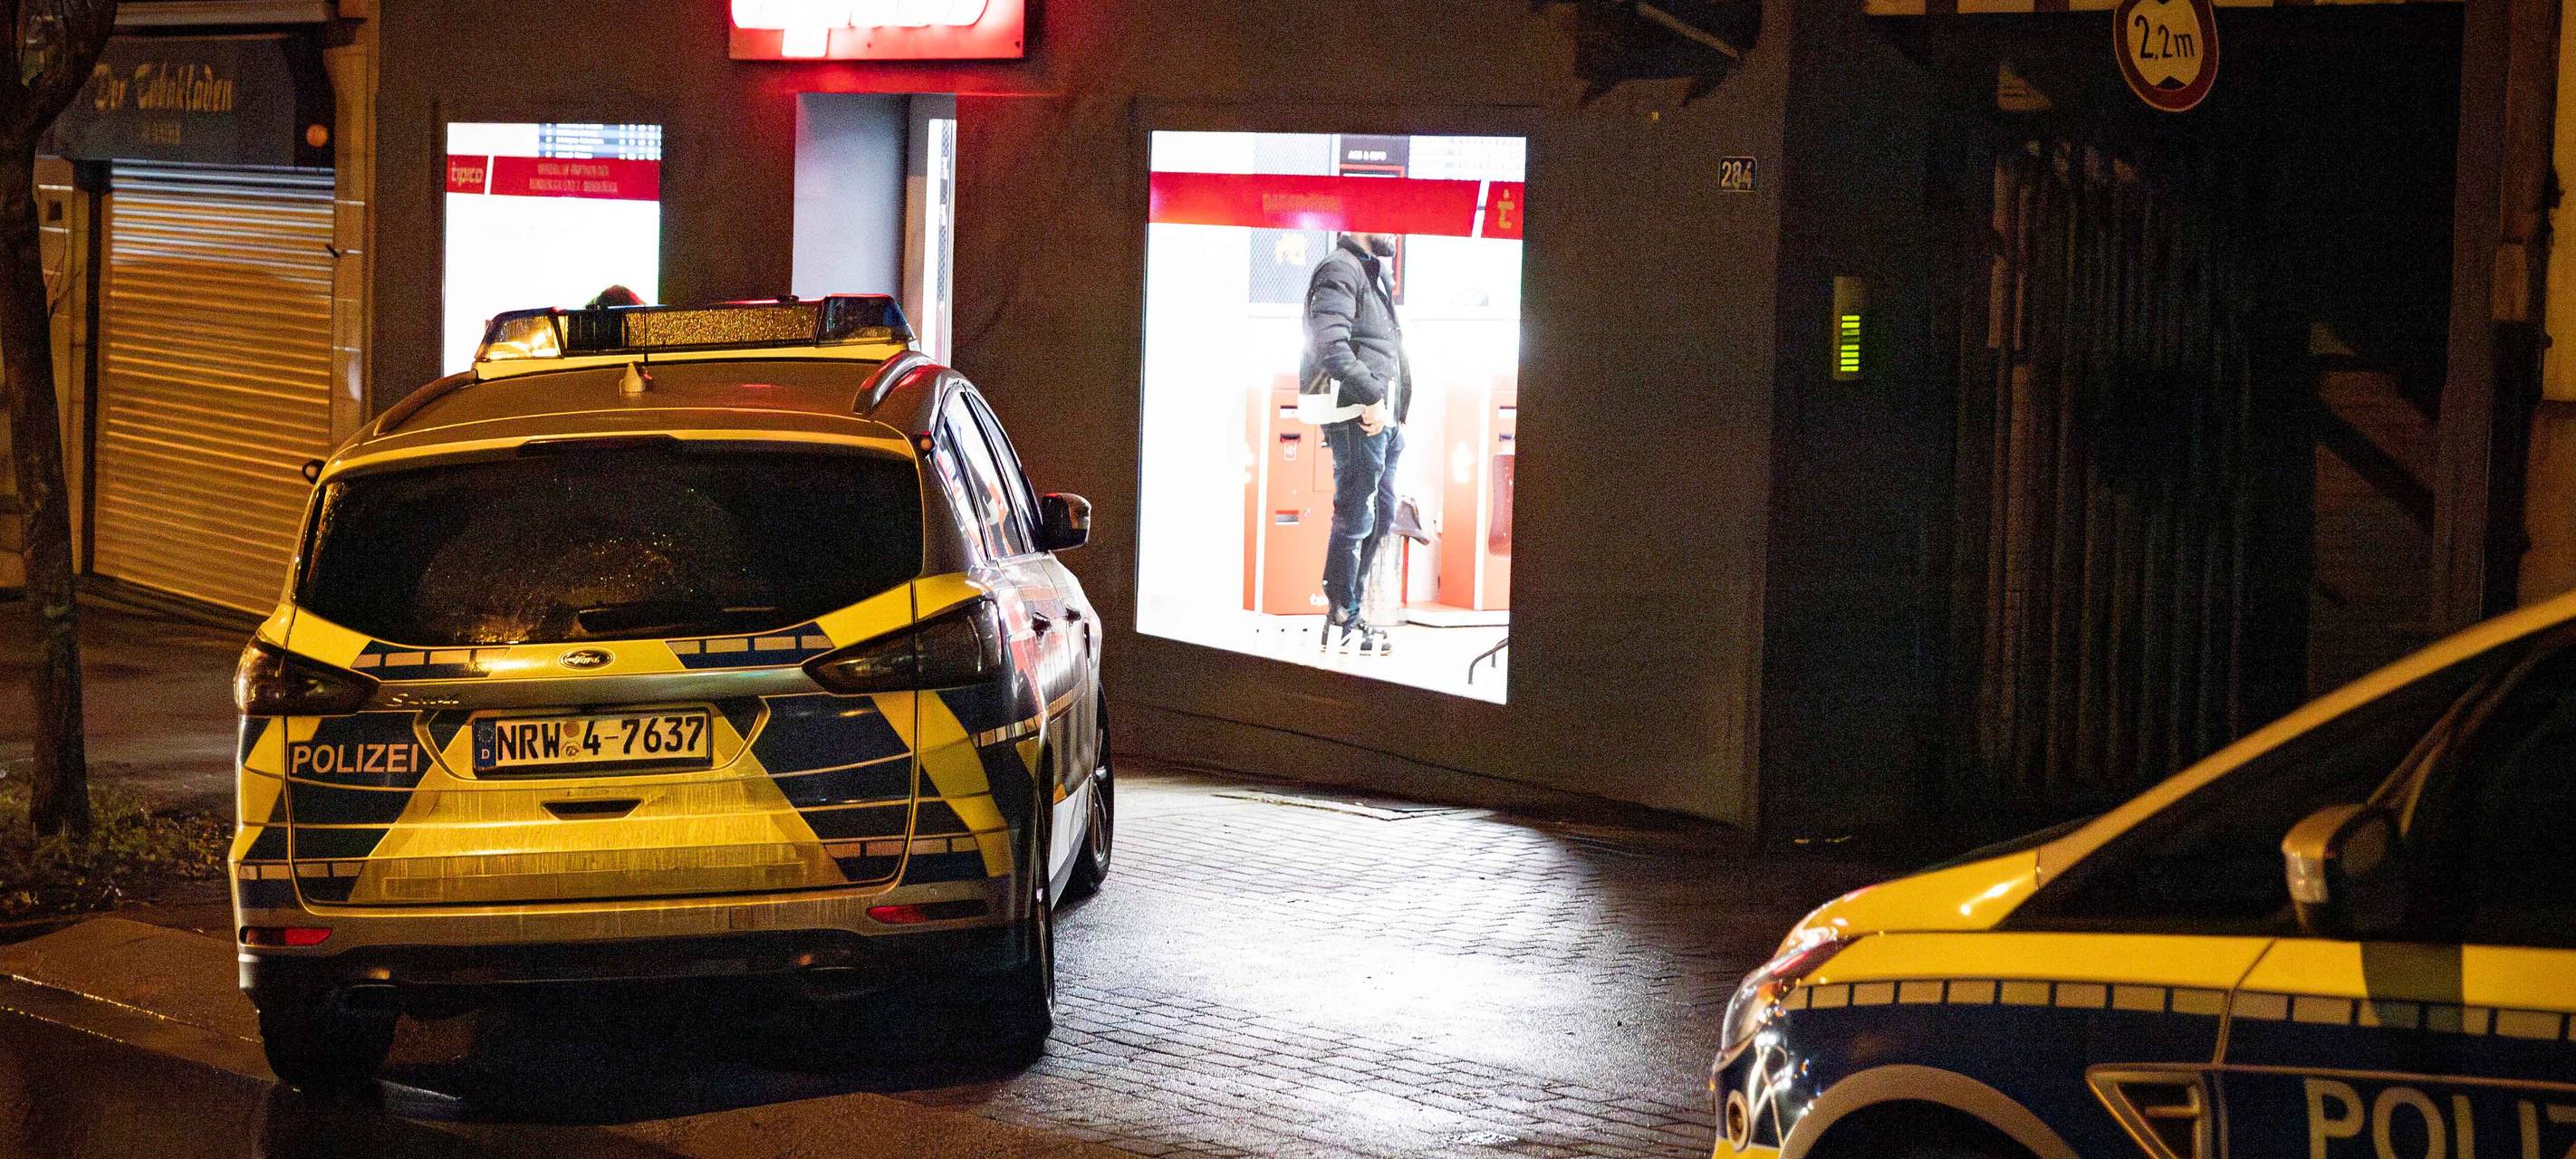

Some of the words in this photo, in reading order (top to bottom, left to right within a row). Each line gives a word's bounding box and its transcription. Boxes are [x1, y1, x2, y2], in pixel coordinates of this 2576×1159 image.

[1721, 160, 1752, 189] 284
[498, 721, 561, 760] NRW
[582, 716, 705, 755] 4-7637
[291, 742, 419, 774] POLIZEI
[481, 749, 490, 760] D
